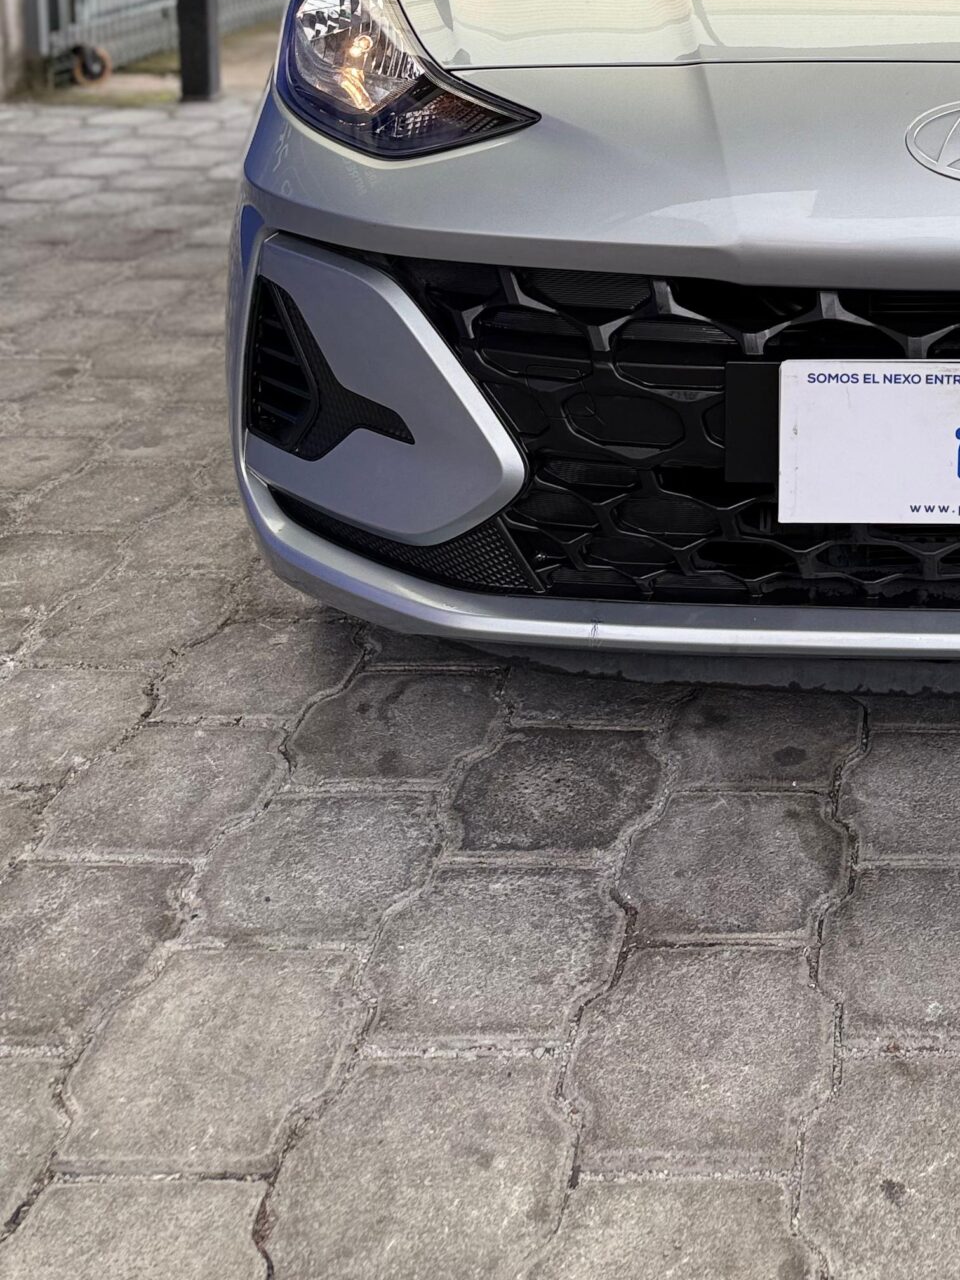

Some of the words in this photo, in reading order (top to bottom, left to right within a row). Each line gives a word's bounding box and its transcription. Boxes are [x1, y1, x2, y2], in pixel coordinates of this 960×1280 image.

[807, 372, 860, 385] SOMOS
[863, 373, 880, 385] EL
[883, 373, 922, 385] NEXO
